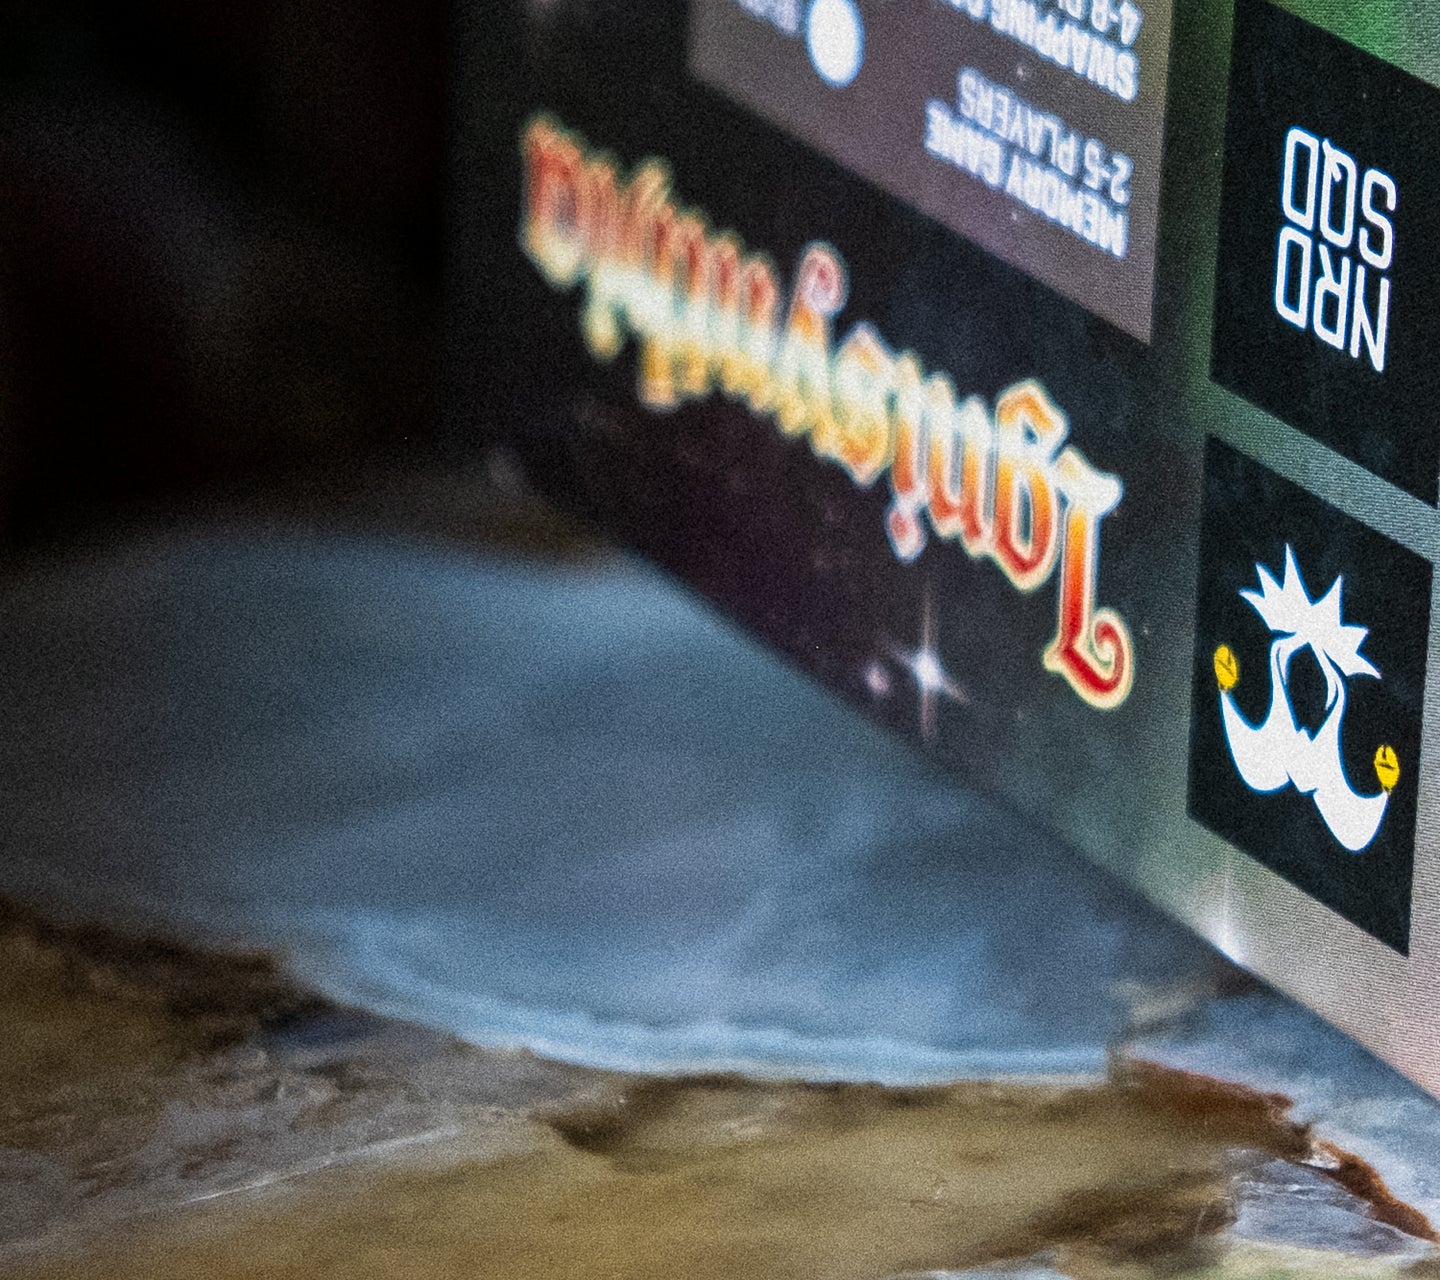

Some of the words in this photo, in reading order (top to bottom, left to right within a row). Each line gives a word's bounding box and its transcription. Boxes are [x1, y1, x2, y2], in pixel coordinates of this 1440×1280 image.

[924, 97, 1004, 191] GAME
[957, 66, 1080, 178] PLAYERS
[1083, 138, 1134, 206] 2-5
[1003, 151, 1129, 259] MEMORY
[1281, 126, 1397, 270] SQD
[1275, 225, 1391, 372] NRD
[520, 110, 1134, 710] Ignisynthia
